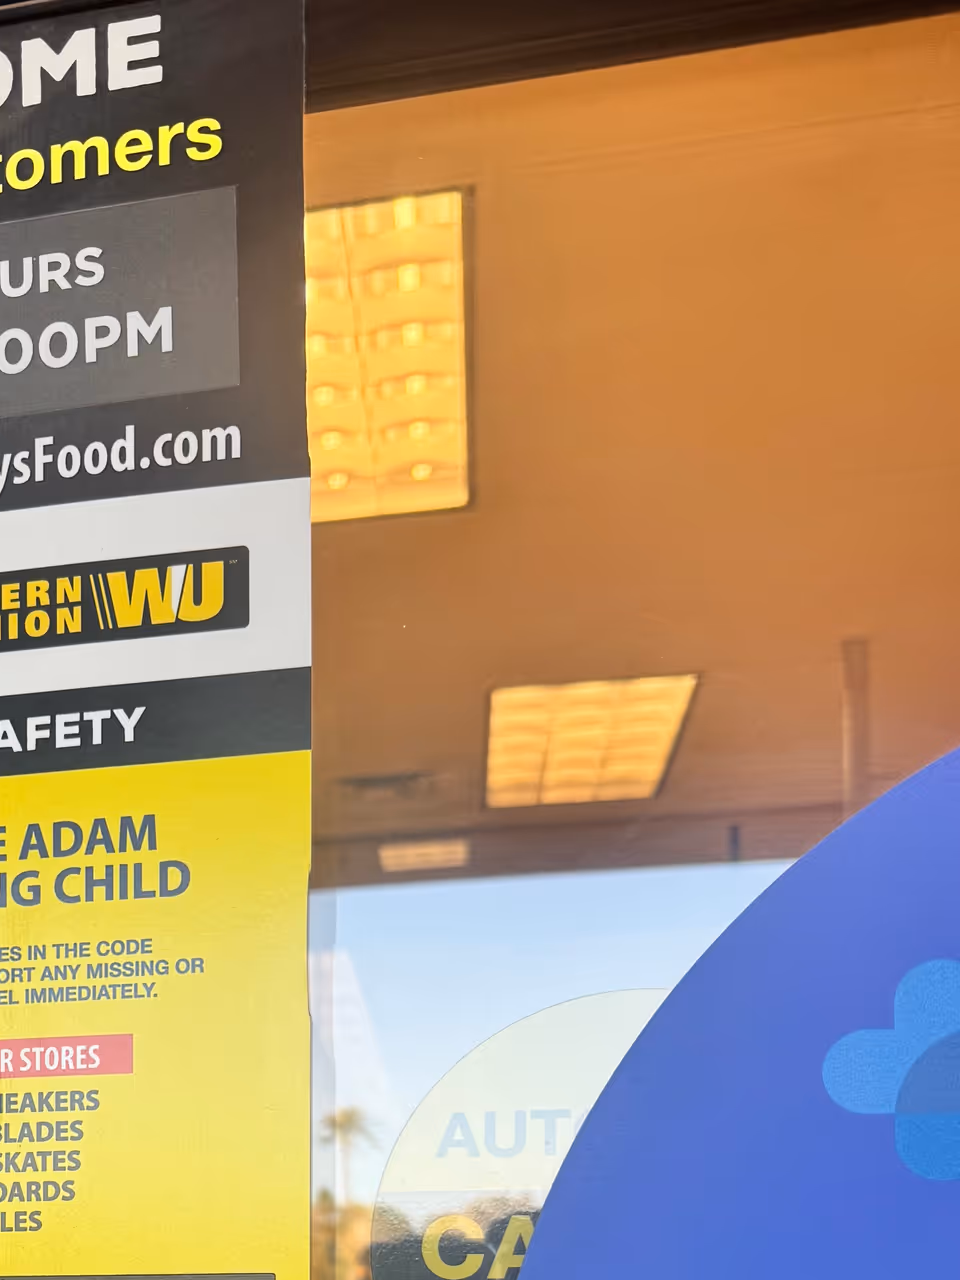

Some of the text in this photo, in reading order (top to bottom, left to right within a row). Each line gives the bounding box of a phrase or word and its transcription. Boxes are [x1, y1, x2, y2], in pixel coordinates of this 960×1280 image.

[19, 815, 156, 860] ADAM
[54, 861, 190, 904] CHILD
[27, 945, 46, 961] IN
[52, 943, 90, 959] THE
[96, 939, 152, 957] CODE
[20, 1045, 100, 1071] STORES
